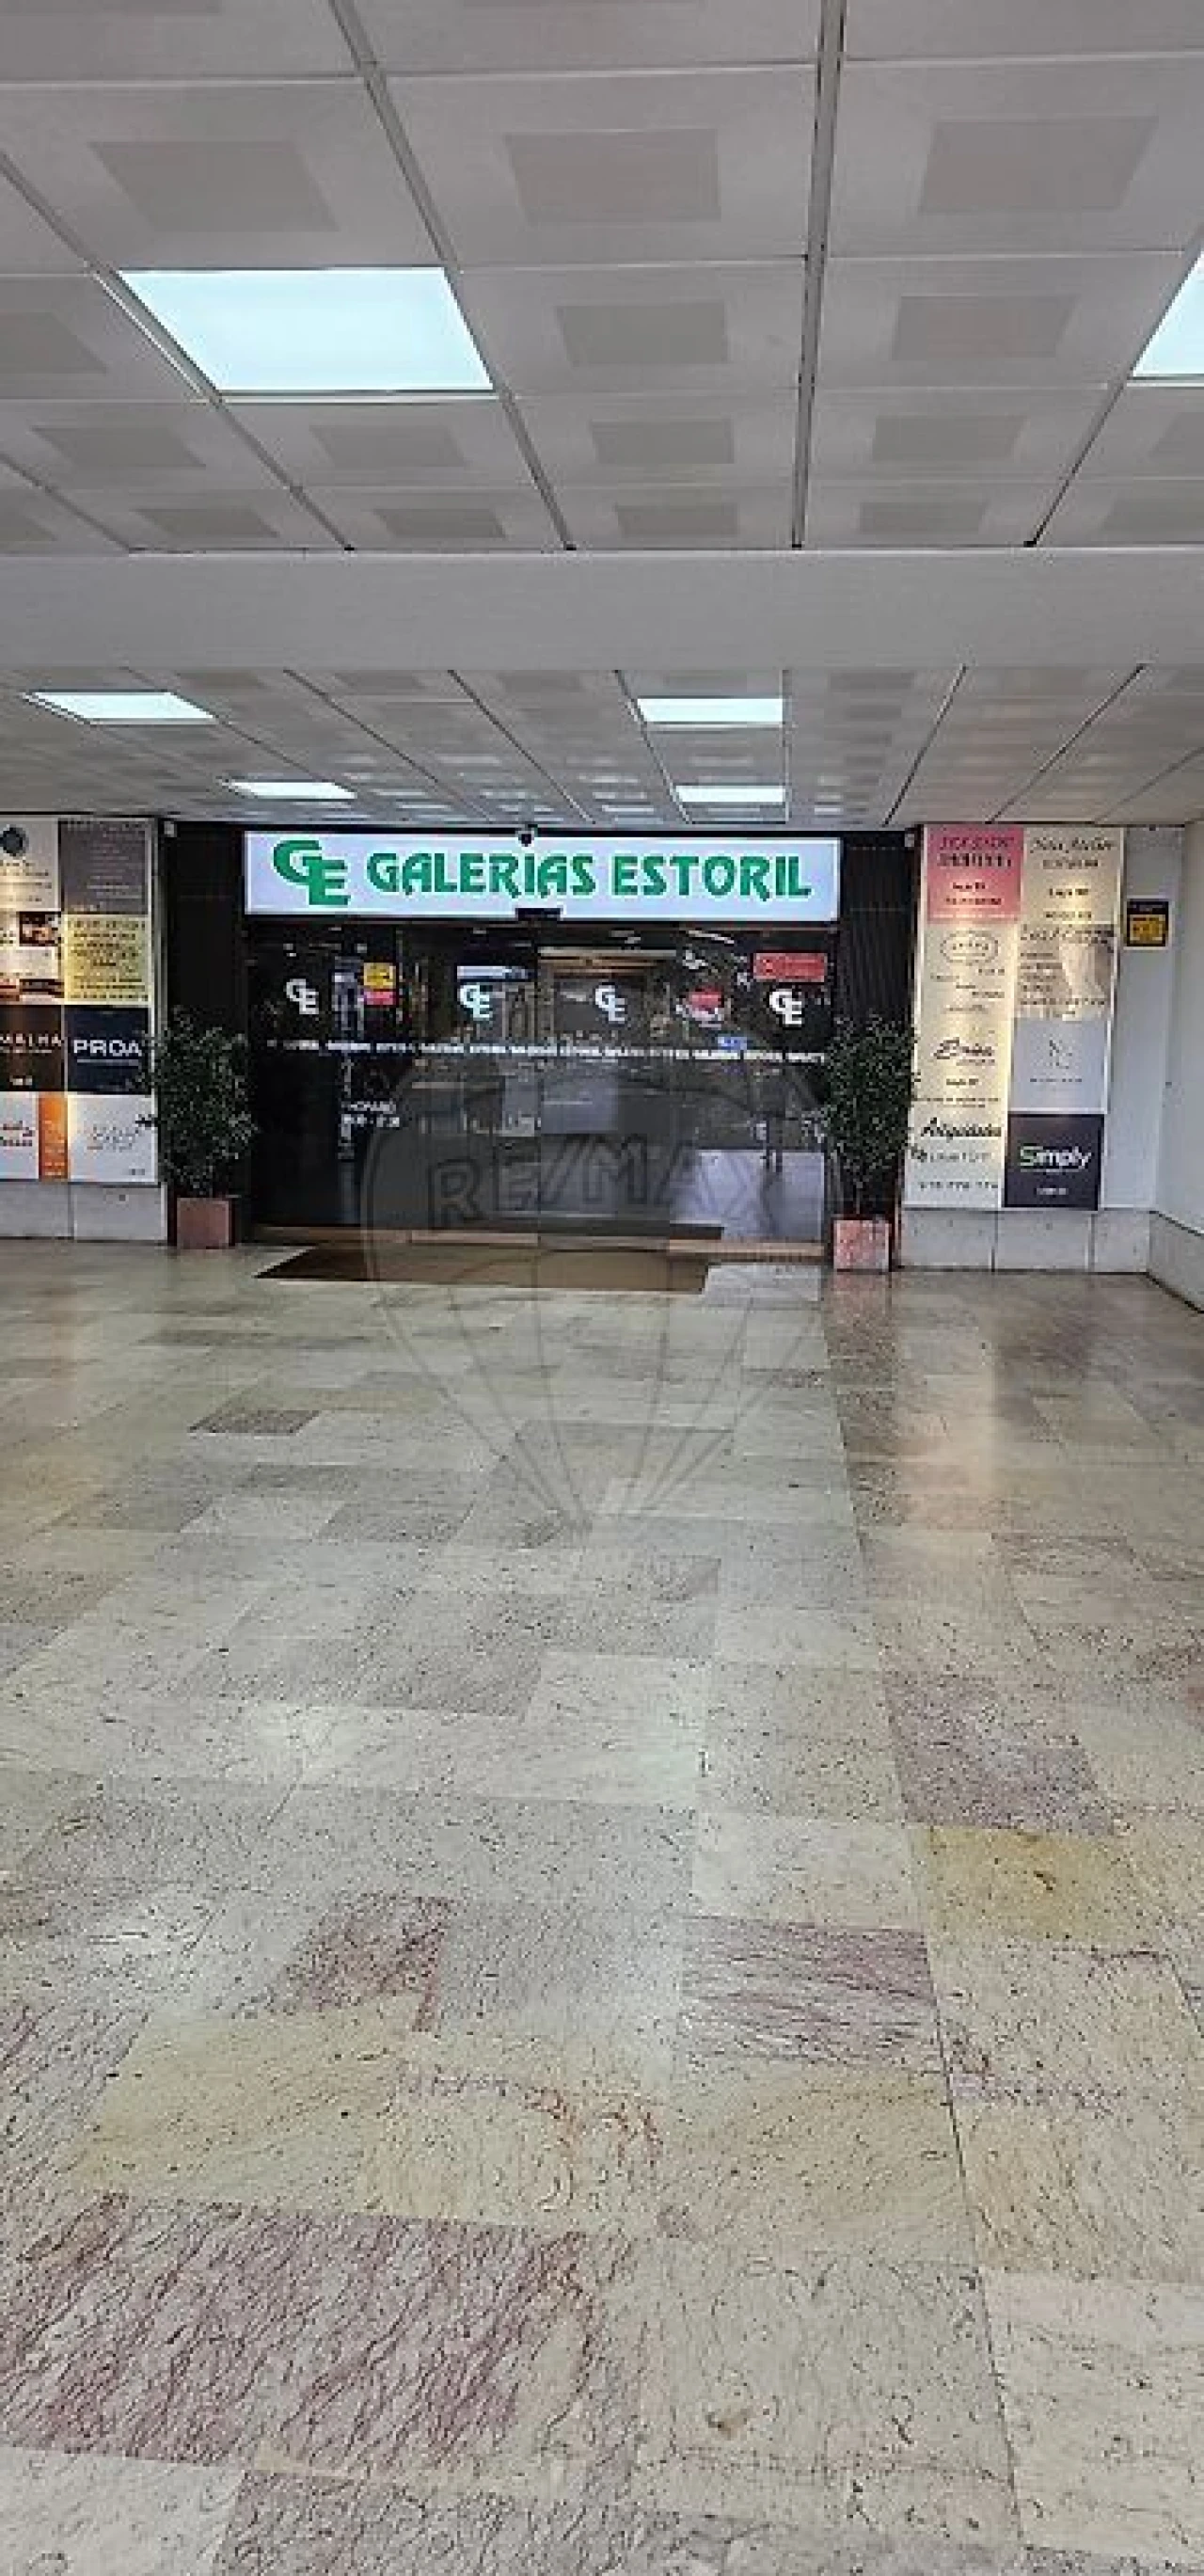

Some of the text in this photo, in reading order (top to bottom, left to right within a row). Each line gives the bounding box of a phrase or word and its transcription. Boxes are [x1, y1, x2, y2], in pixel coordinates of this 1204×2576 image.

[367, 852, 812, 901] GALERIAS ESTORIL
[73, 1039, 143, 1057] PROA
[1019, 1144, 1092, 1169] Simply
